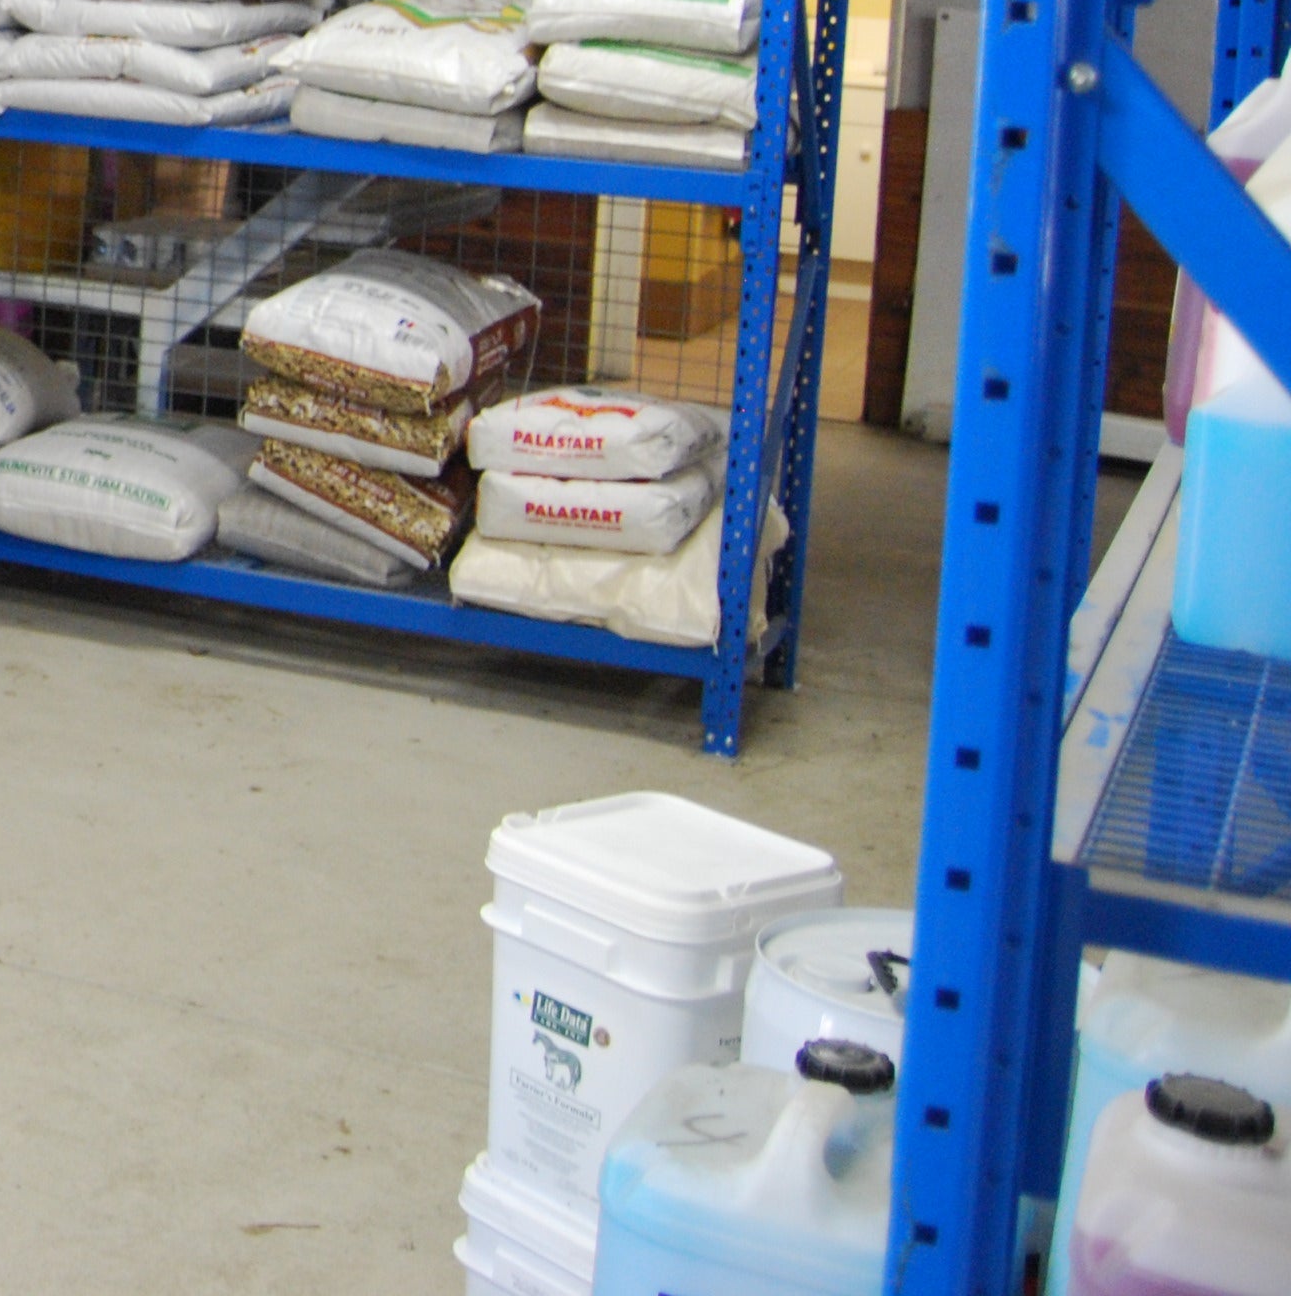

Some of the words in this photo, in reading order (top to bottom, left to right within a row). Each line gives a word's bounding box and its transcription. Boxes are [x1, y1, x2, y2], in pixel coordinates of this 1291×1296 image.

[512, 430, 606, 451] PALASTART
[58, 470, 91, 486] STUD
[524, 502, 624, 525] PALASTART
[536, 994, 558, 1020] Life
[559, 1006, 590, 1030] Data
[554, 1094, 594, 1123] Formula
